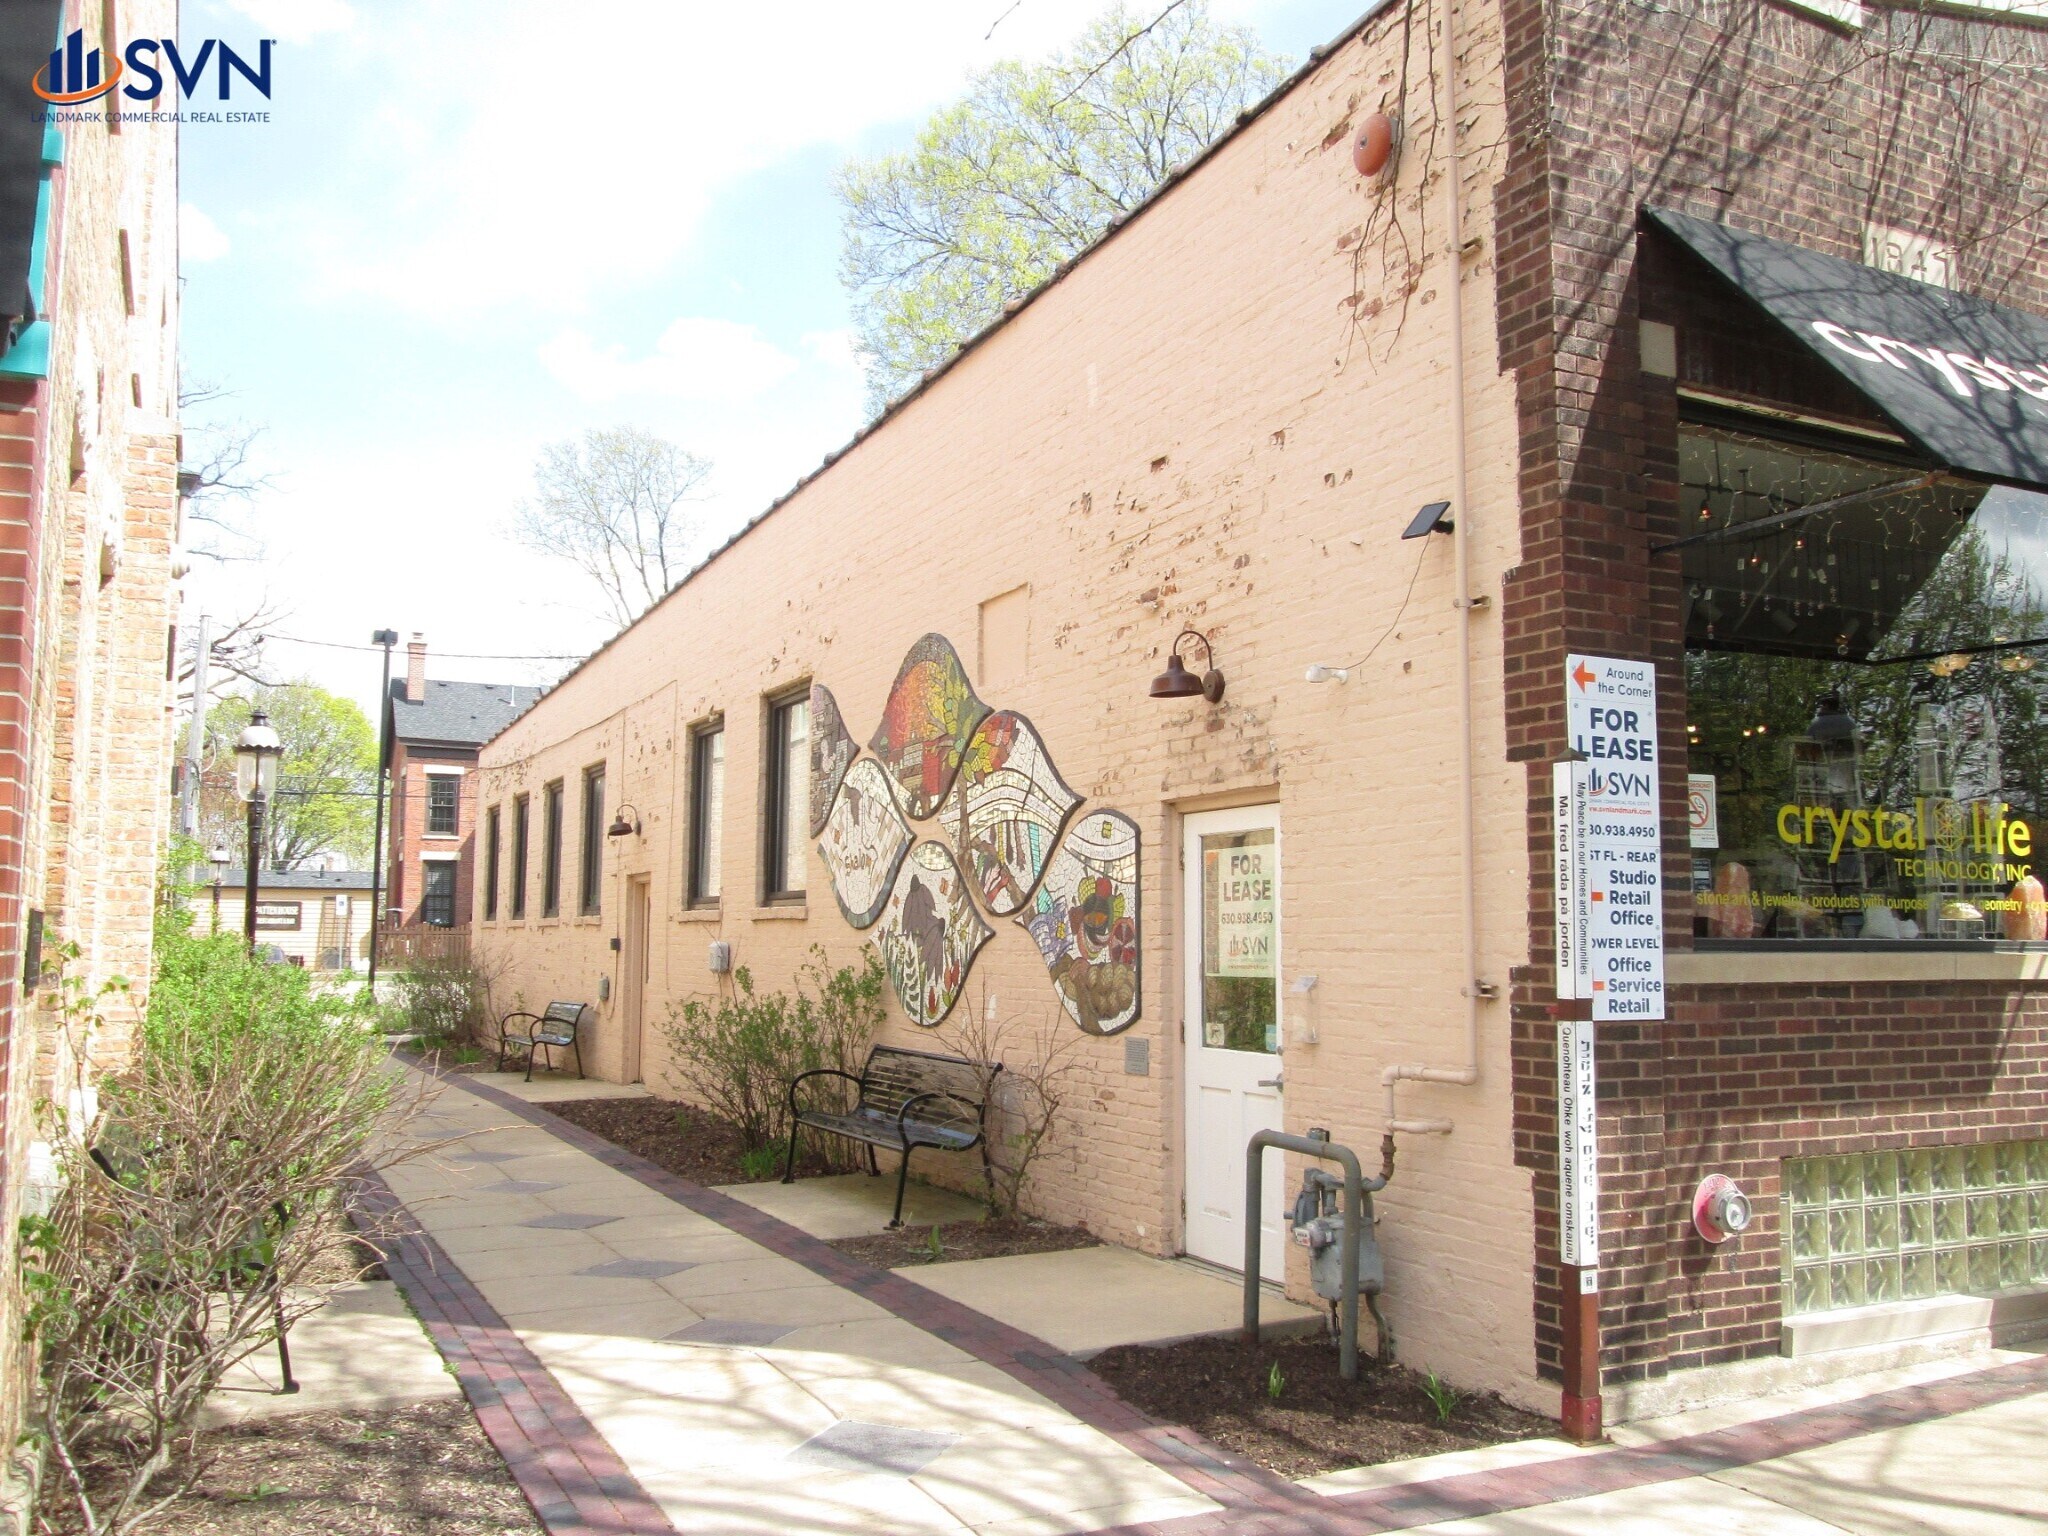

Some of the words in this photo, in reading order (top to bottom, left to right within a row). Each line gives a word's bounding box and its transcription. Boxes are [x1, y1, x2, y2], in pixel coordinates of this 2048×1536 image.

[1811, 320, 2048, 401] crysta
[1606, 667, 1644, 681] Around
[1598, 682, 1615, 694] the
[1617, 684, 1652, 698] Corner
[1590, 707, 1639, 733] FOR
[1577, 734, 1654, 762] LEASE
[1576, 782, 1586, 799] May
[1608, 772, 1650, 797] SVN
[1577, 801, 1586, 825] Peace
[1559, 823, 1569, 852] fred
[1578, 828, 1586, 838] be
[1777, 797, 1926, 864] crystal
[1972, 801, 2031, 858] life
[1578, 841, 1587, 849] in
[1230, 853, 1262, 876] FOR
[1578, 851, 1586, 866] our
[1604, 850, 1617, 861] FL
[1627, 851, 1656, 863] REAR
[1579, 868, 1587, 898] Homes
[1609, 869, 1657, 885] Studio
[1223, 879, 1272, 902] LEASE
[1609, 890, 1651, 905] Retail
[1696, 890, 1729, 906] stone
[1751, 890, 1760, 906] &
[1812, 892, 1860, 909] products
[1863, 894, 1884, 908] with
[1579, 900, 1588, 916] and
[1610, 910, 1654, 926] Office
[1559, 921, 1570, 968] jorden
[1579, 918, 1589, 975] Communities
[1625, 938, 1659, 949] LEVEL
[1608, 957, 1652, 972] Office
[1608, 978, 1661, 993] Service
[1608, 998, 1650, 1013] Retail
[1563, 1097, 1573, 1126] Ohke
[1564, 1130, 1573, 1153] woh
